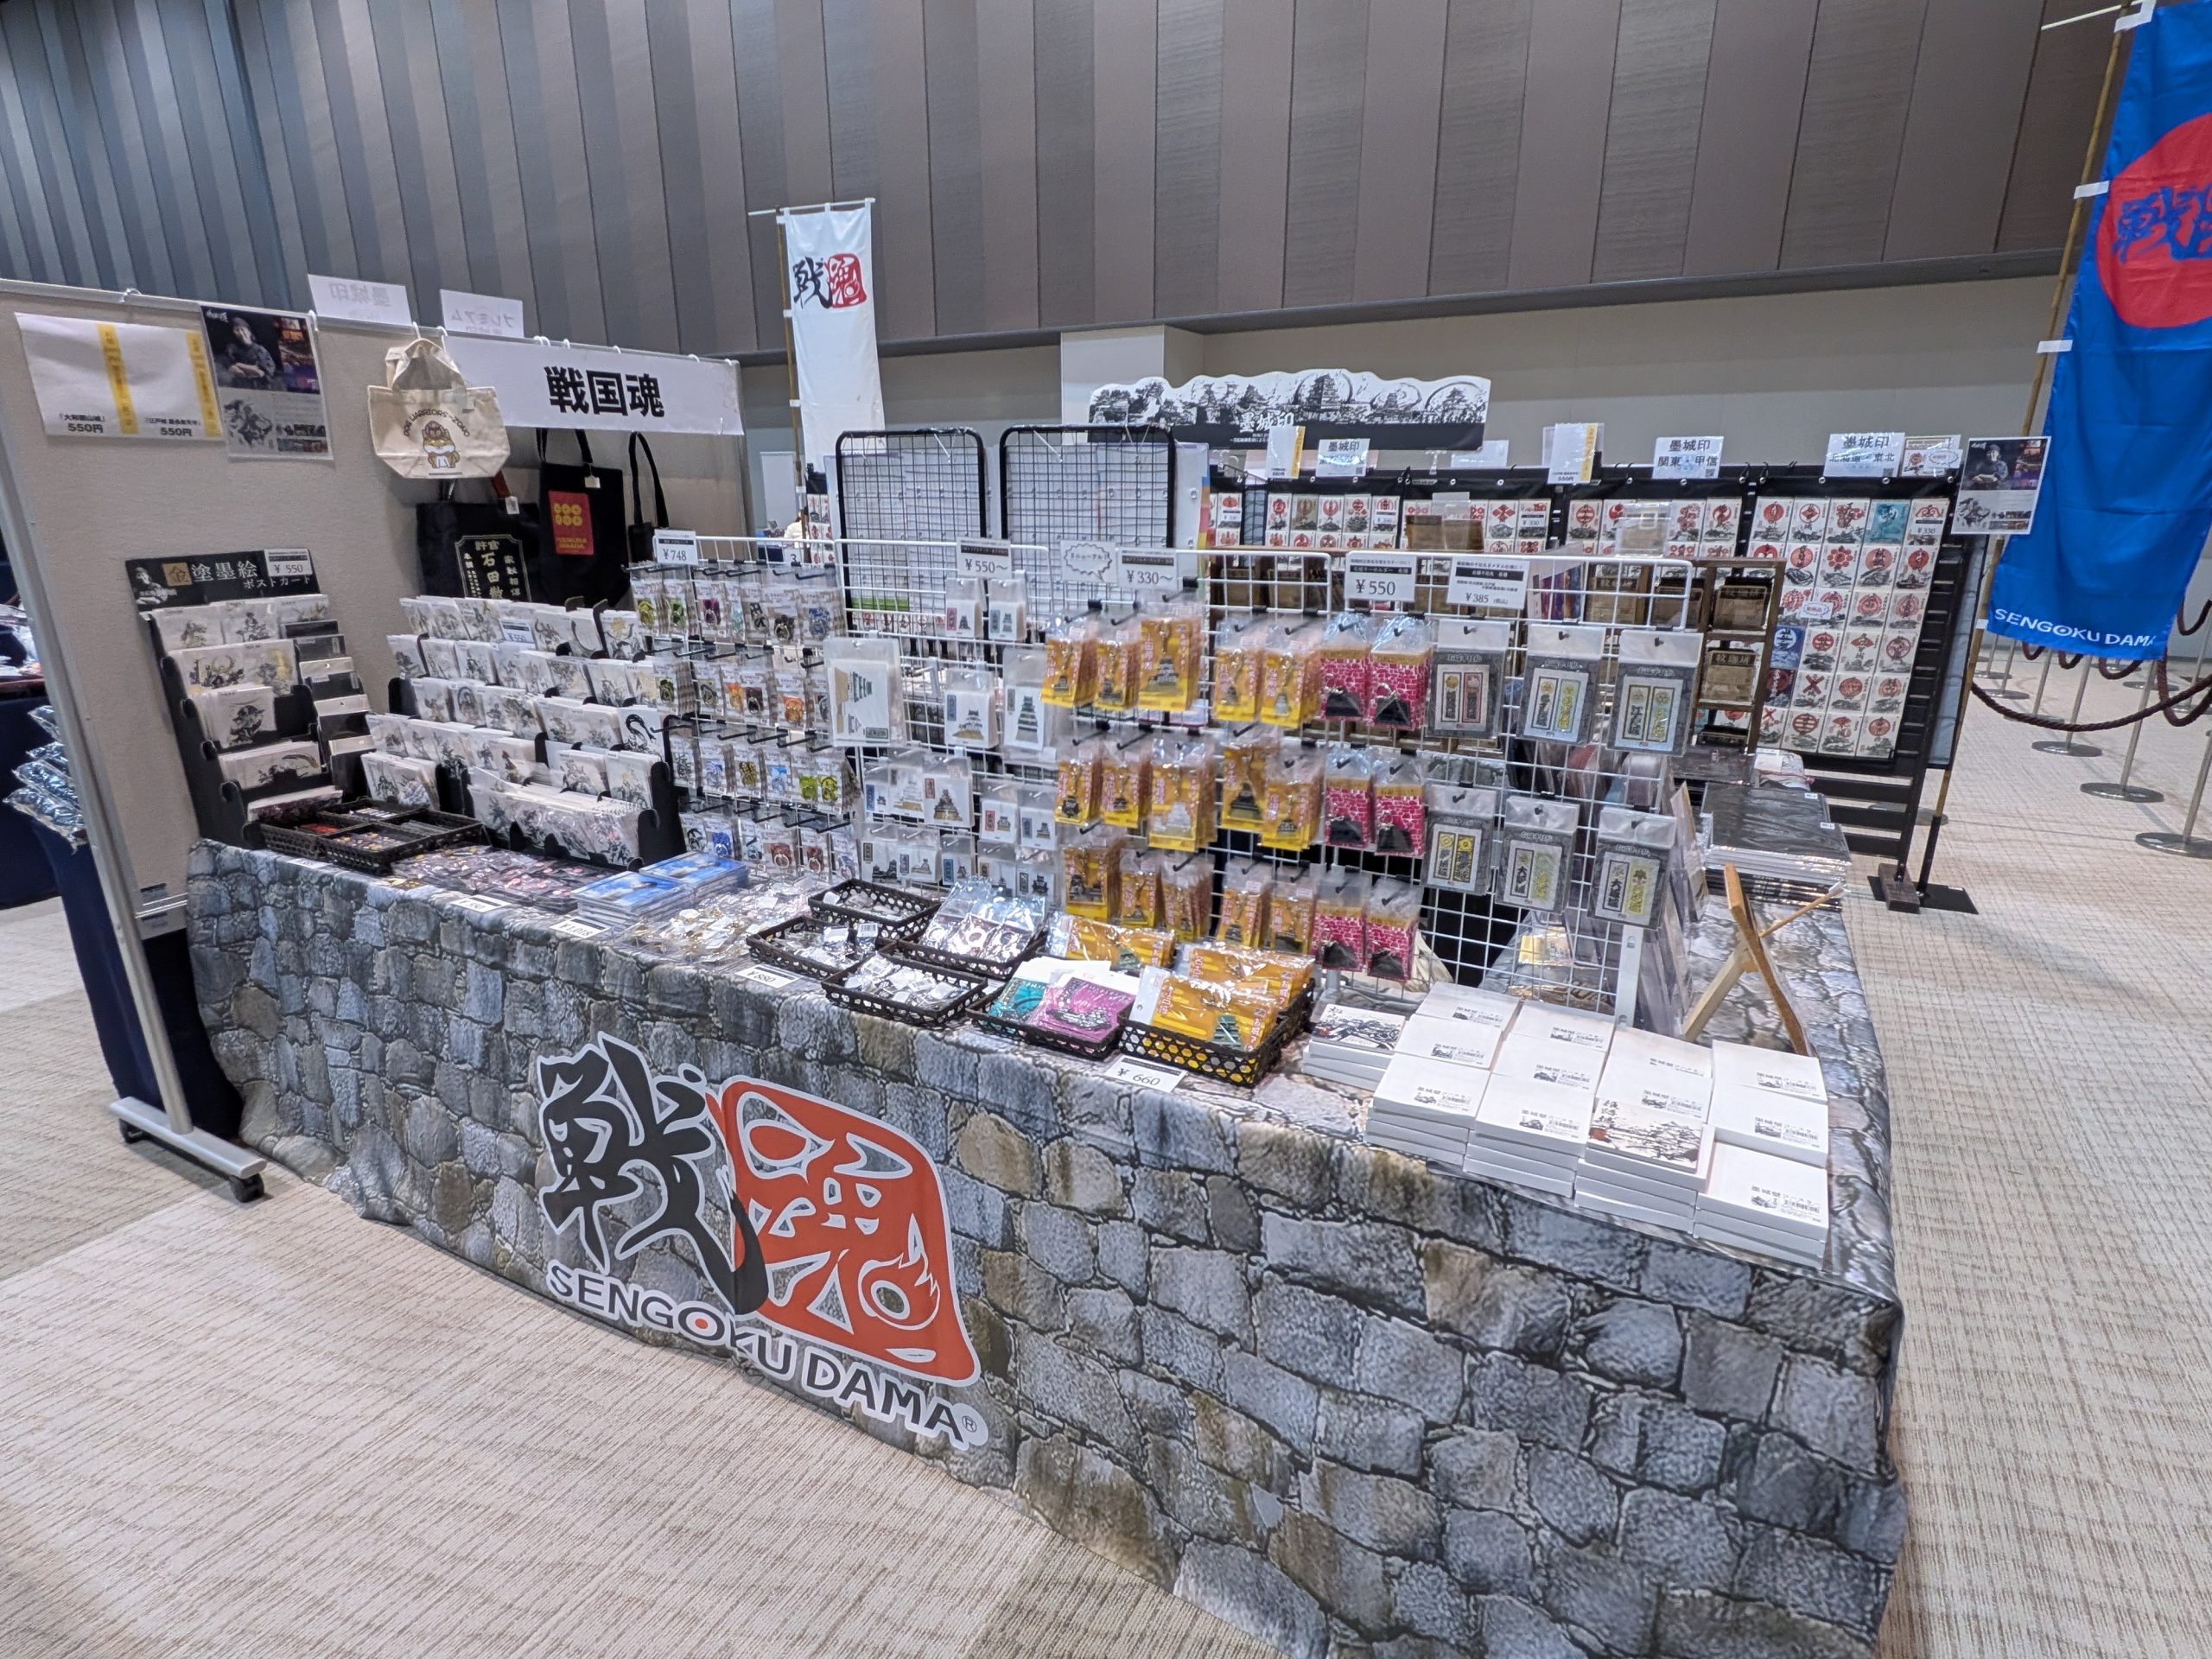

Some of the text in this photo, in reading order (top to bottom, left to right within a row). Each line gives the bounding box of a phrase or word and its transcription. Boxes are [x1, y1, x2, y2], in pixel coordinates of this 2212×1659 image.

[544, 366, 665, 417] 戦国魂
[67, 423, 104, 434] 550円
[161, 427, 193, 437] 550円
[1328, 441, 1360, 453] 墨城印
[1669, 440, 1711, 452] 墨城印
[1657, 455, 1719, 467] 関東・甲信
[663, 548, 687, 561] ¥748
[243, 576, 311, 589] ポストカード
[1356, 578, 1396, 595] ¥550
[1465, 592, 1490, 603] ¥385
[1994, 608, 2101, 642] SENGOKU
[1132, 1073, 1161, 1086] 660
[548, 1263, 793, 1377] SENGOKU
